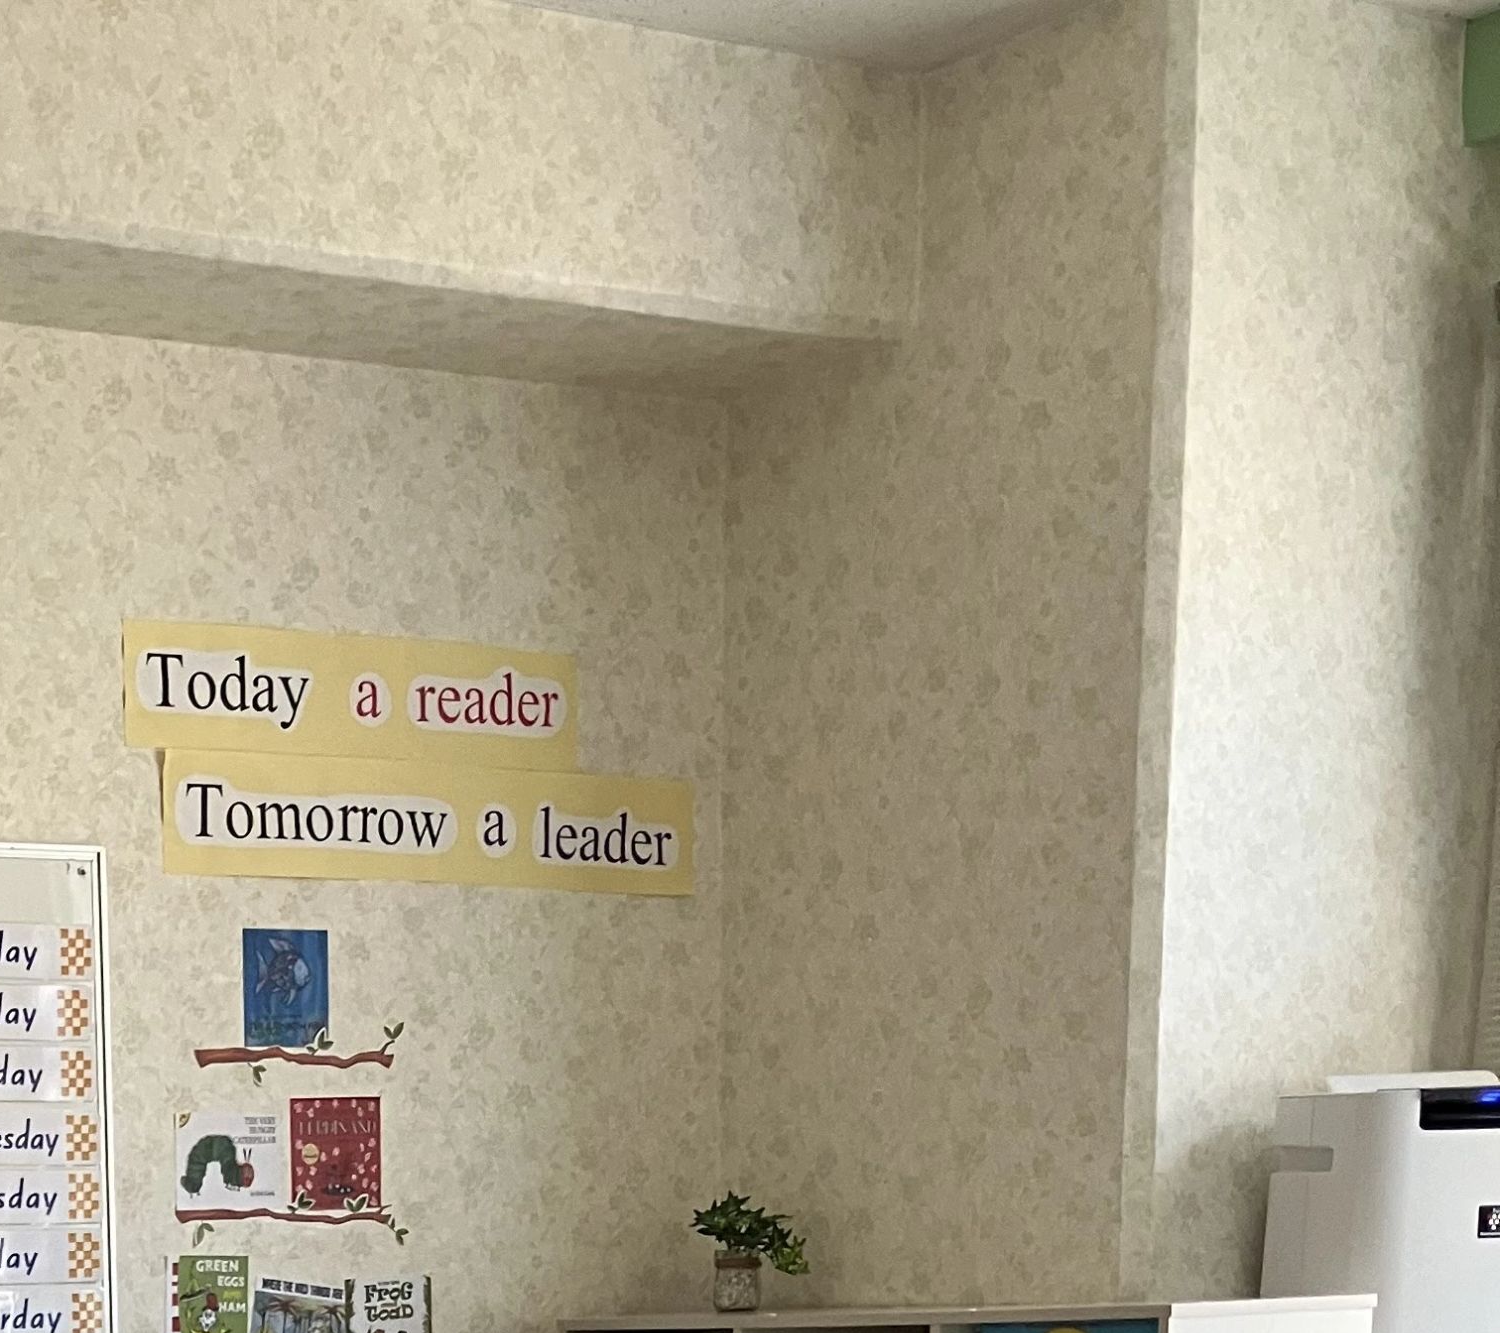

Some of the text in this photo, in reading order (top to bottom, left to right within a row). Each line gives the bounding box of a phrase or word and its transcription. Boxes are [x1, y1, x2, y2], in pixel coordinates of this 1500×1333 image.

[145, 652, 559, 730] Today a reader
[186, 783, 673, 866] Tomorrow a leader
[196, 1259, 239, 1273] GREEN
[217, 1275, 245, 1287] EGGS
[218, 1302, 246, 1313] HAM
